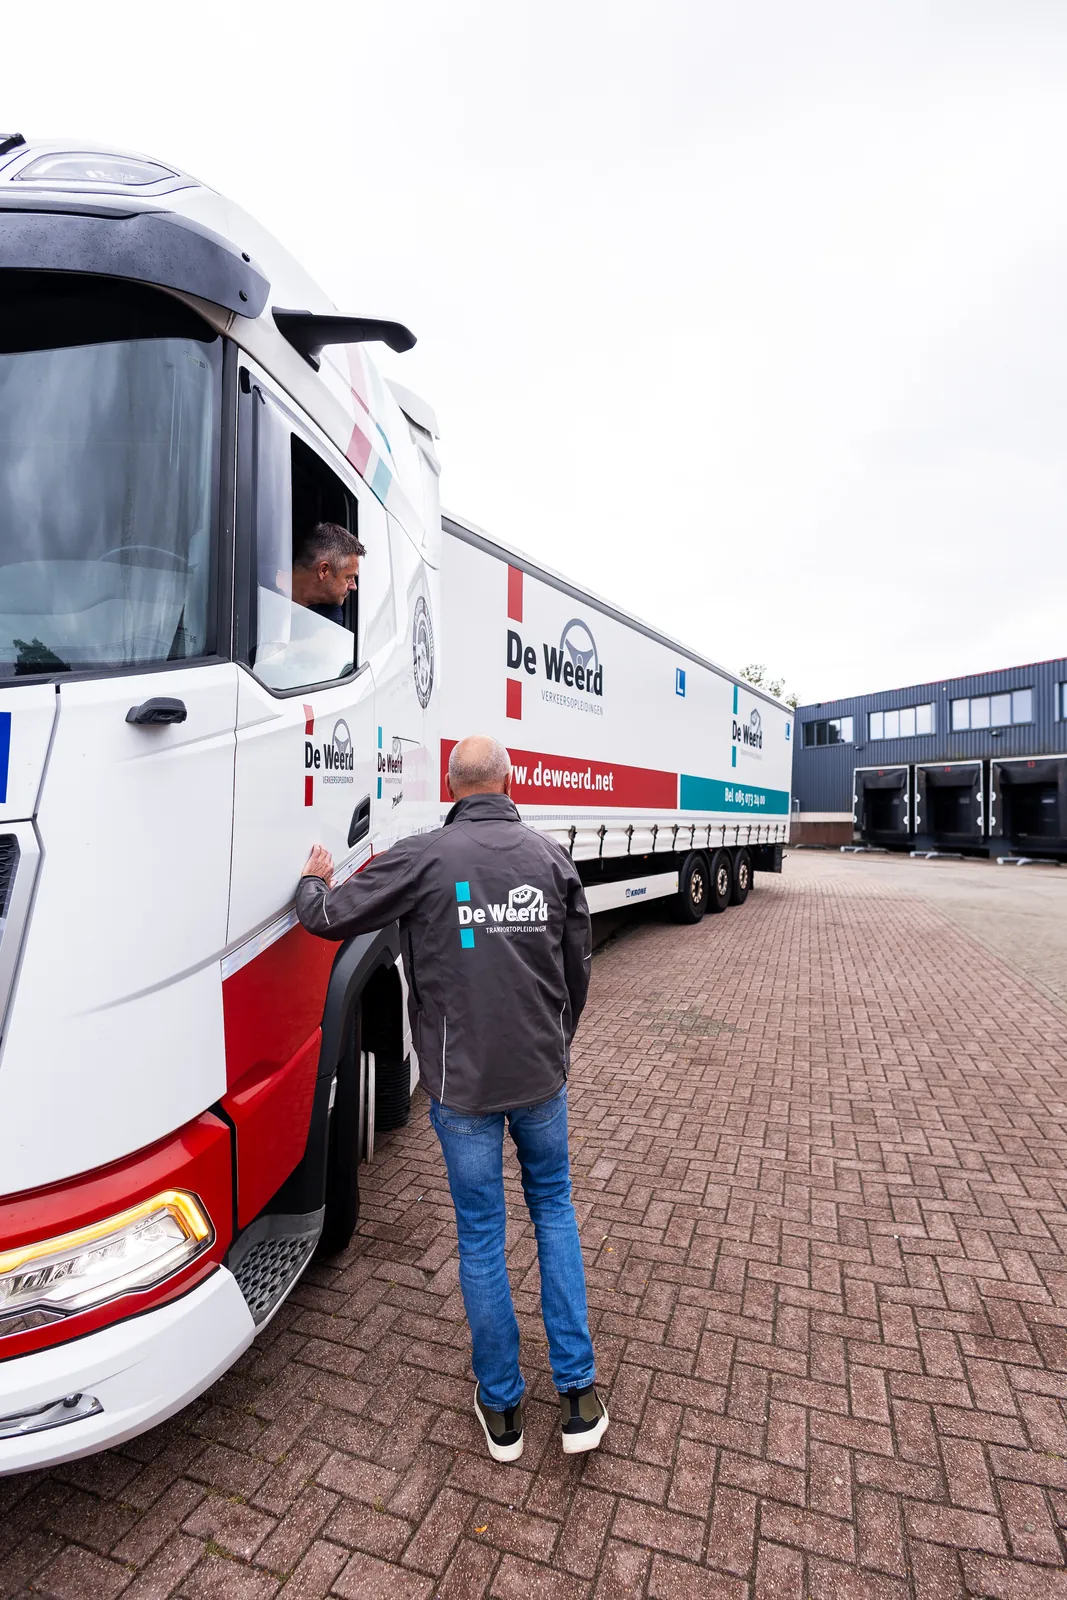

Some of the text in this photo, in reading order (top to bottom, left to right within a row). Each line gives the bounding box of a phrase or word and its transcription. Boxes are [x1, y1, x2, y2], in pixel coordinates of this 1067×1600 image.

[507, 629, 603, 696] De Weerd
[677, 669, 684, 694] L
[541, 690, 604, 716] VERKEERSOPLEIDINGEN
[732, 720, 763, 749] De Weerd
[305, 741, 354, 771] De Weerd
[377, 752, 403, 774] De Weerd
[511, 761, 614, 791] w.deweerd.net
[724, 787, 734, 802] Bel
[458, 902, 549, 925] De Weerd
